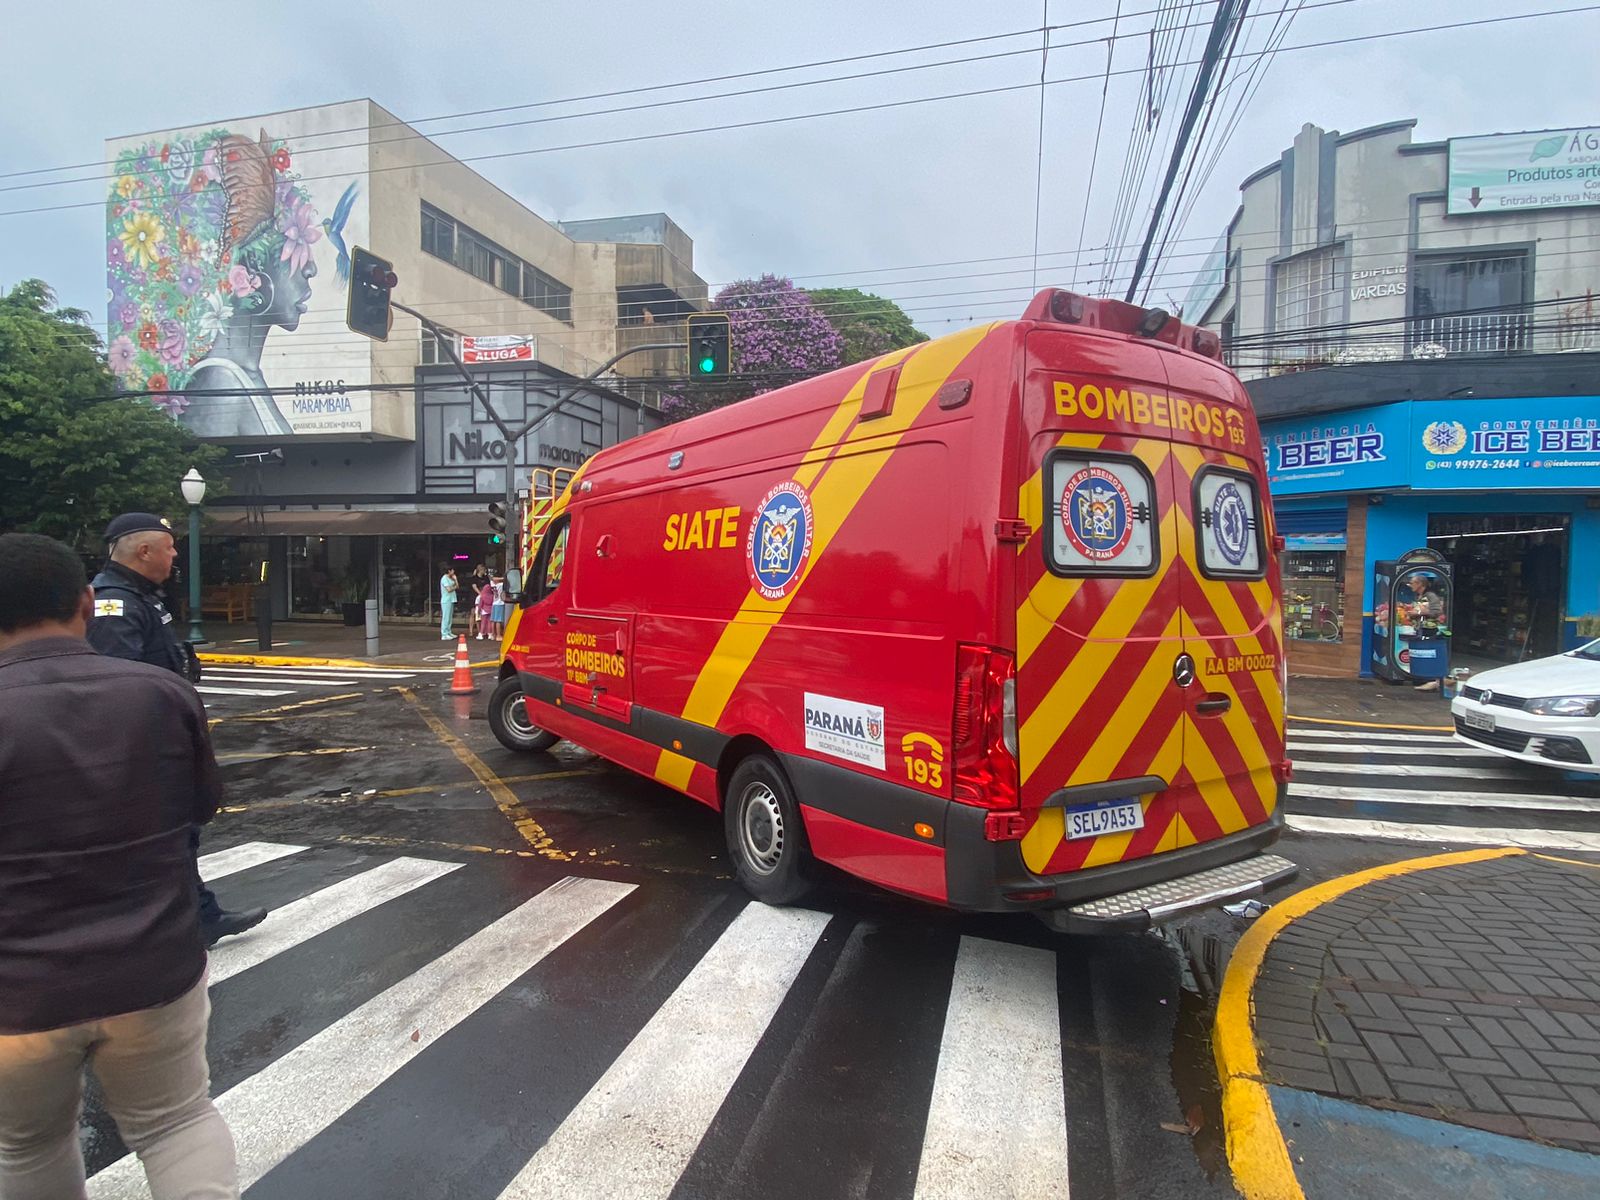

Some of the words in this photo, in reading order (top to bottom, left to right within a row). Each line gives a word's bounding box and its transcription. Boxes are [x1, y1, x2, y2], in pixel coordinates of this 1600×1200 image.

[1508, 168, 1573, 183] Produtos
[1500, 194, 1538, 207] Entrada
[1540, 193, 1562, 205] pela
[1564, 194, 1580, 202] rua
[1350, 282, 1407, 301] VARGAS
[475, 349, 519, 361] ALUGA
[295, 379, 345, 397] NIKOS
[293, 398, 353, 414] MARAMBAIA
[1053, 381, 1226, 438] BOMBEIROS
[1228, 426, 1246, 446] 193
[1470, 430, 1530, 454] ICE
[1277, 432, 1387, 471] BEER
[1454, 459, 1521, 470] 99976-2644
[1062, 491, 1072, 526] CORPO
[1068, 478, 1079, 491] DE
[1078, 469, 1123, 490] BOMBEIROS
[1120, 491, 1133, 530] MILITAR
[1214, 487, 1229, 513] SIATE
[662, 505, 741, 552] SIATE
[746, 515, 758, 558] CORPO
[757, 497, 768, 514] DE
[767, 481, 808, 504] BOMBEIROS
[803, 504, 814, 558] MILITAR
[1085, 549, 1115, 559] PARANÁ
[760, 586, 786, 599] PARANÁ
[566, 632, 587, 646] CORPO
[588, 635, 597, 648] DE
[565, 647, 626, 678] BOMBEIROS
[1206, 657, 1226, 675] AA
[1227, 656, 1244, 673] BM
[1245, 653, 1276, 671] 00022
[805, 707, 866, 739] PARANÁ
[904, 756, 943, 789] 193
[1073, 806, 1136, 834] SEL9A53
